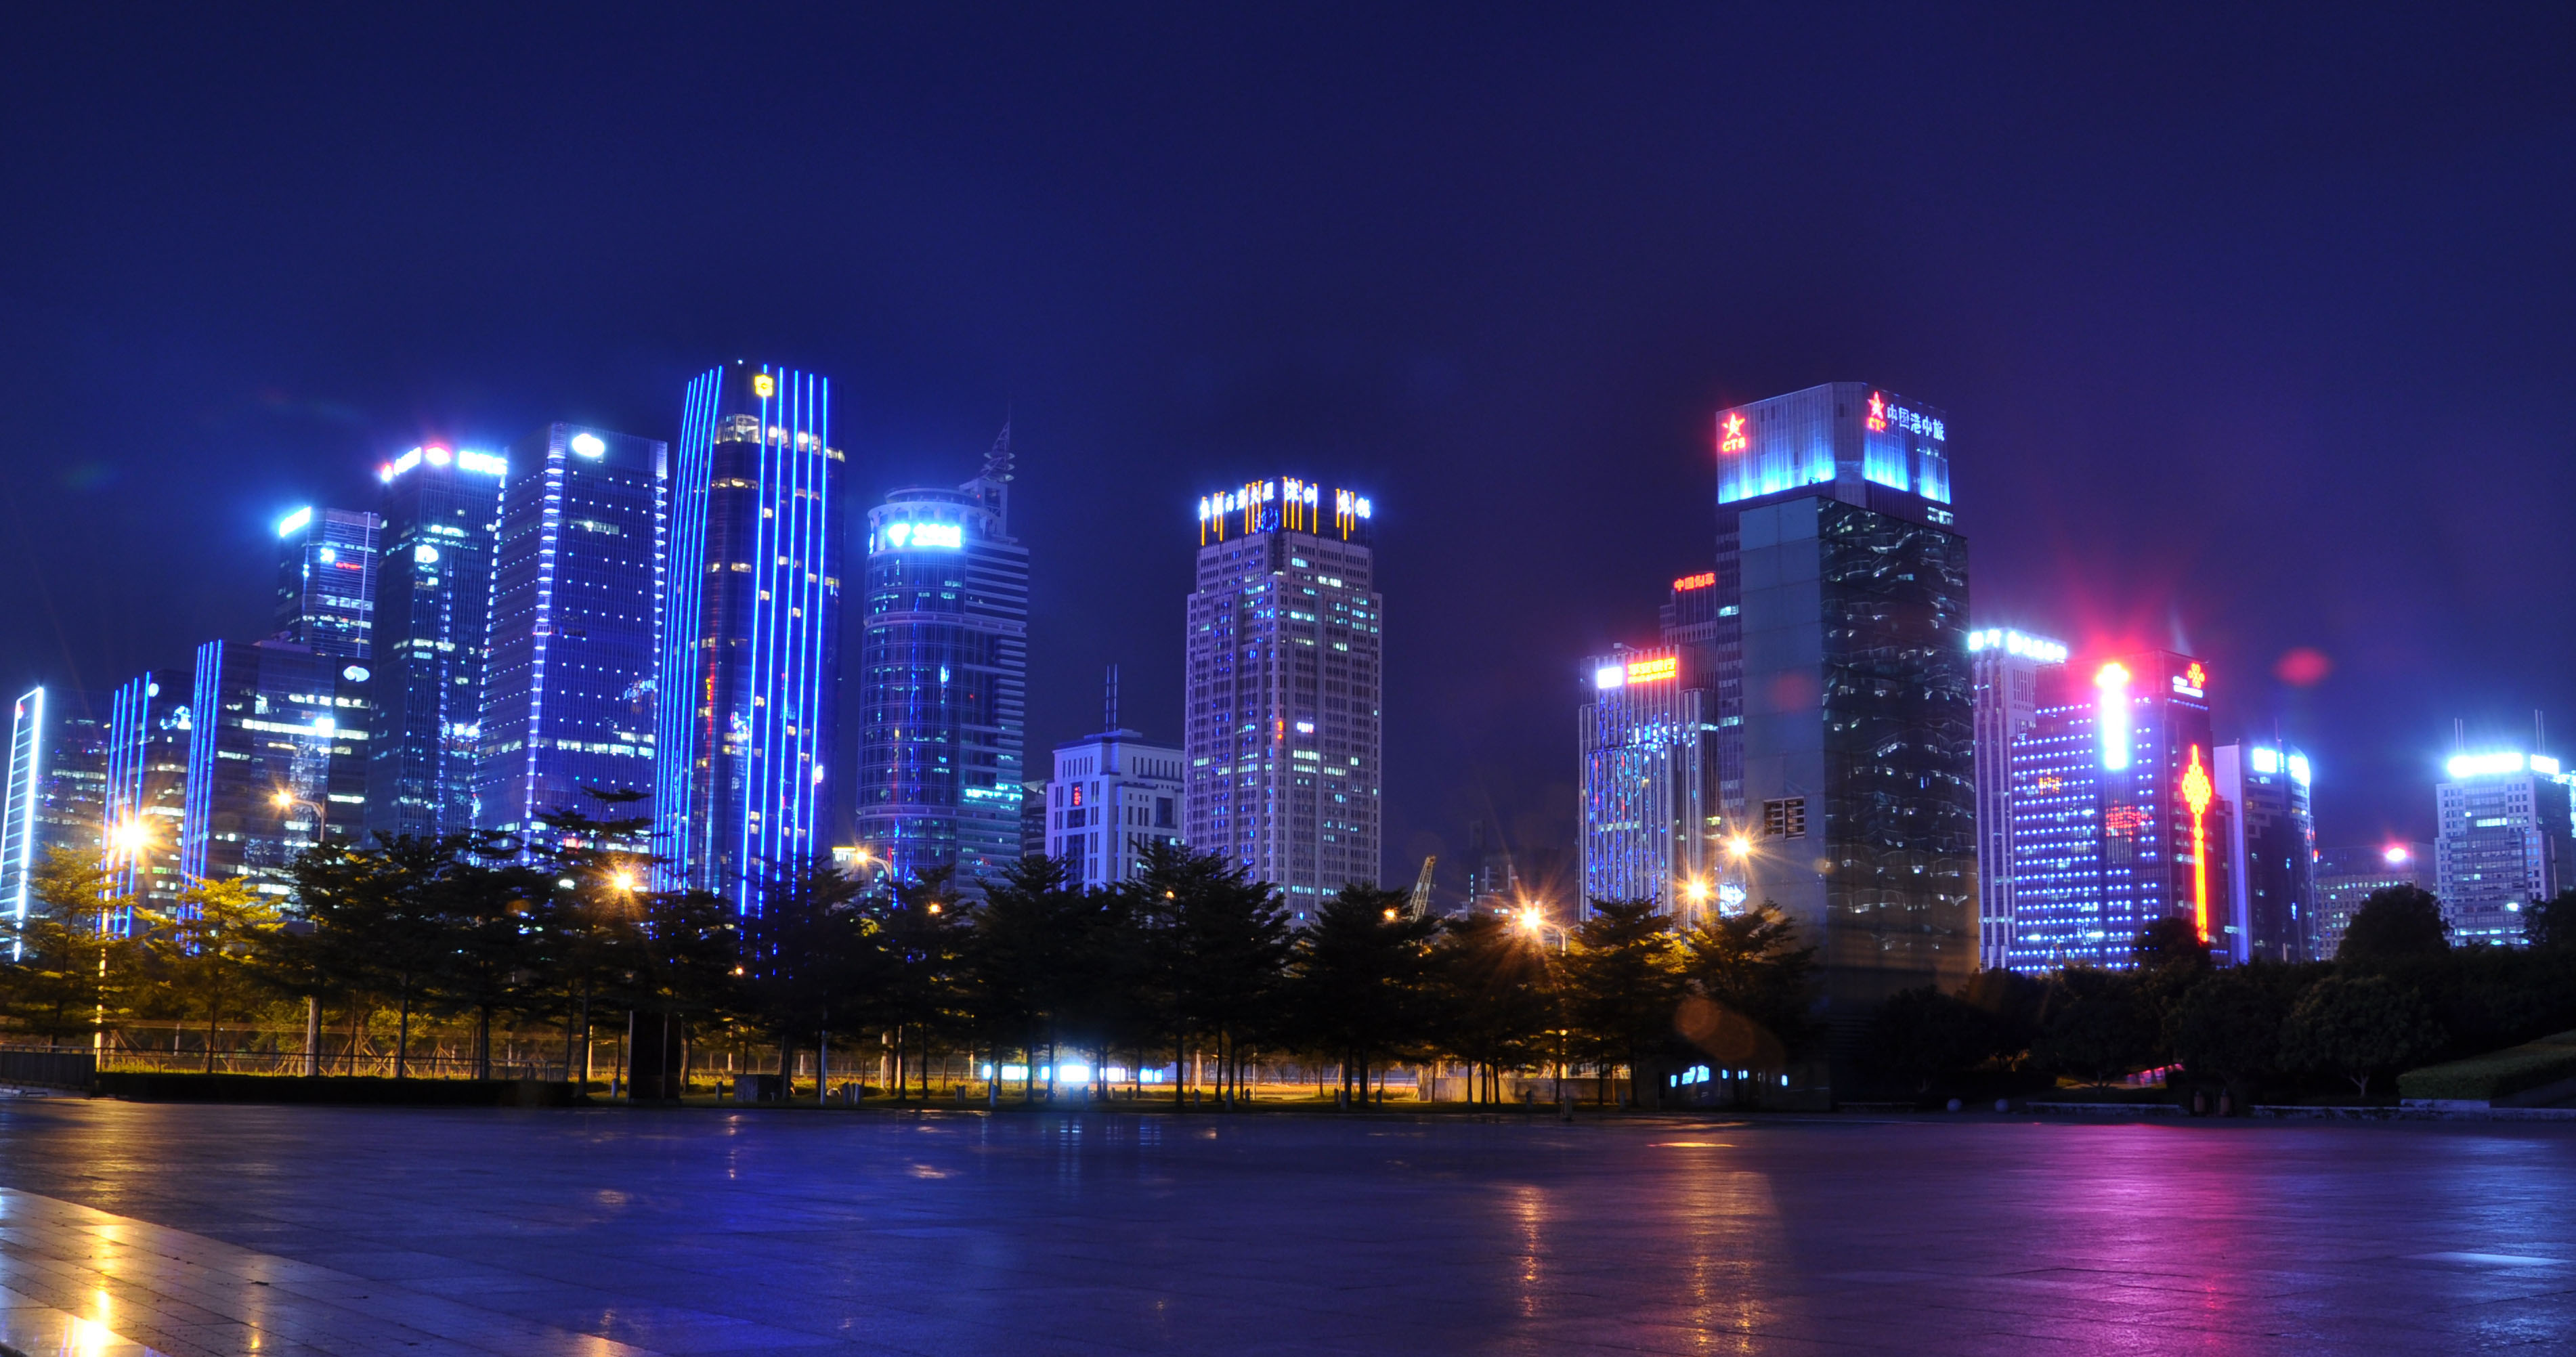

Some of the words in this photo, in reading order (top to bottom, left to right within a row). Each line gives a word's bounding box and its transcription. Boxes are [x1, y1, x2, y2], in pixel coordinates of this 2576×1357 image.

[1887, 404, 1945, 441] 中国港中旅
[1722, 437, 1746, 452] CTS
